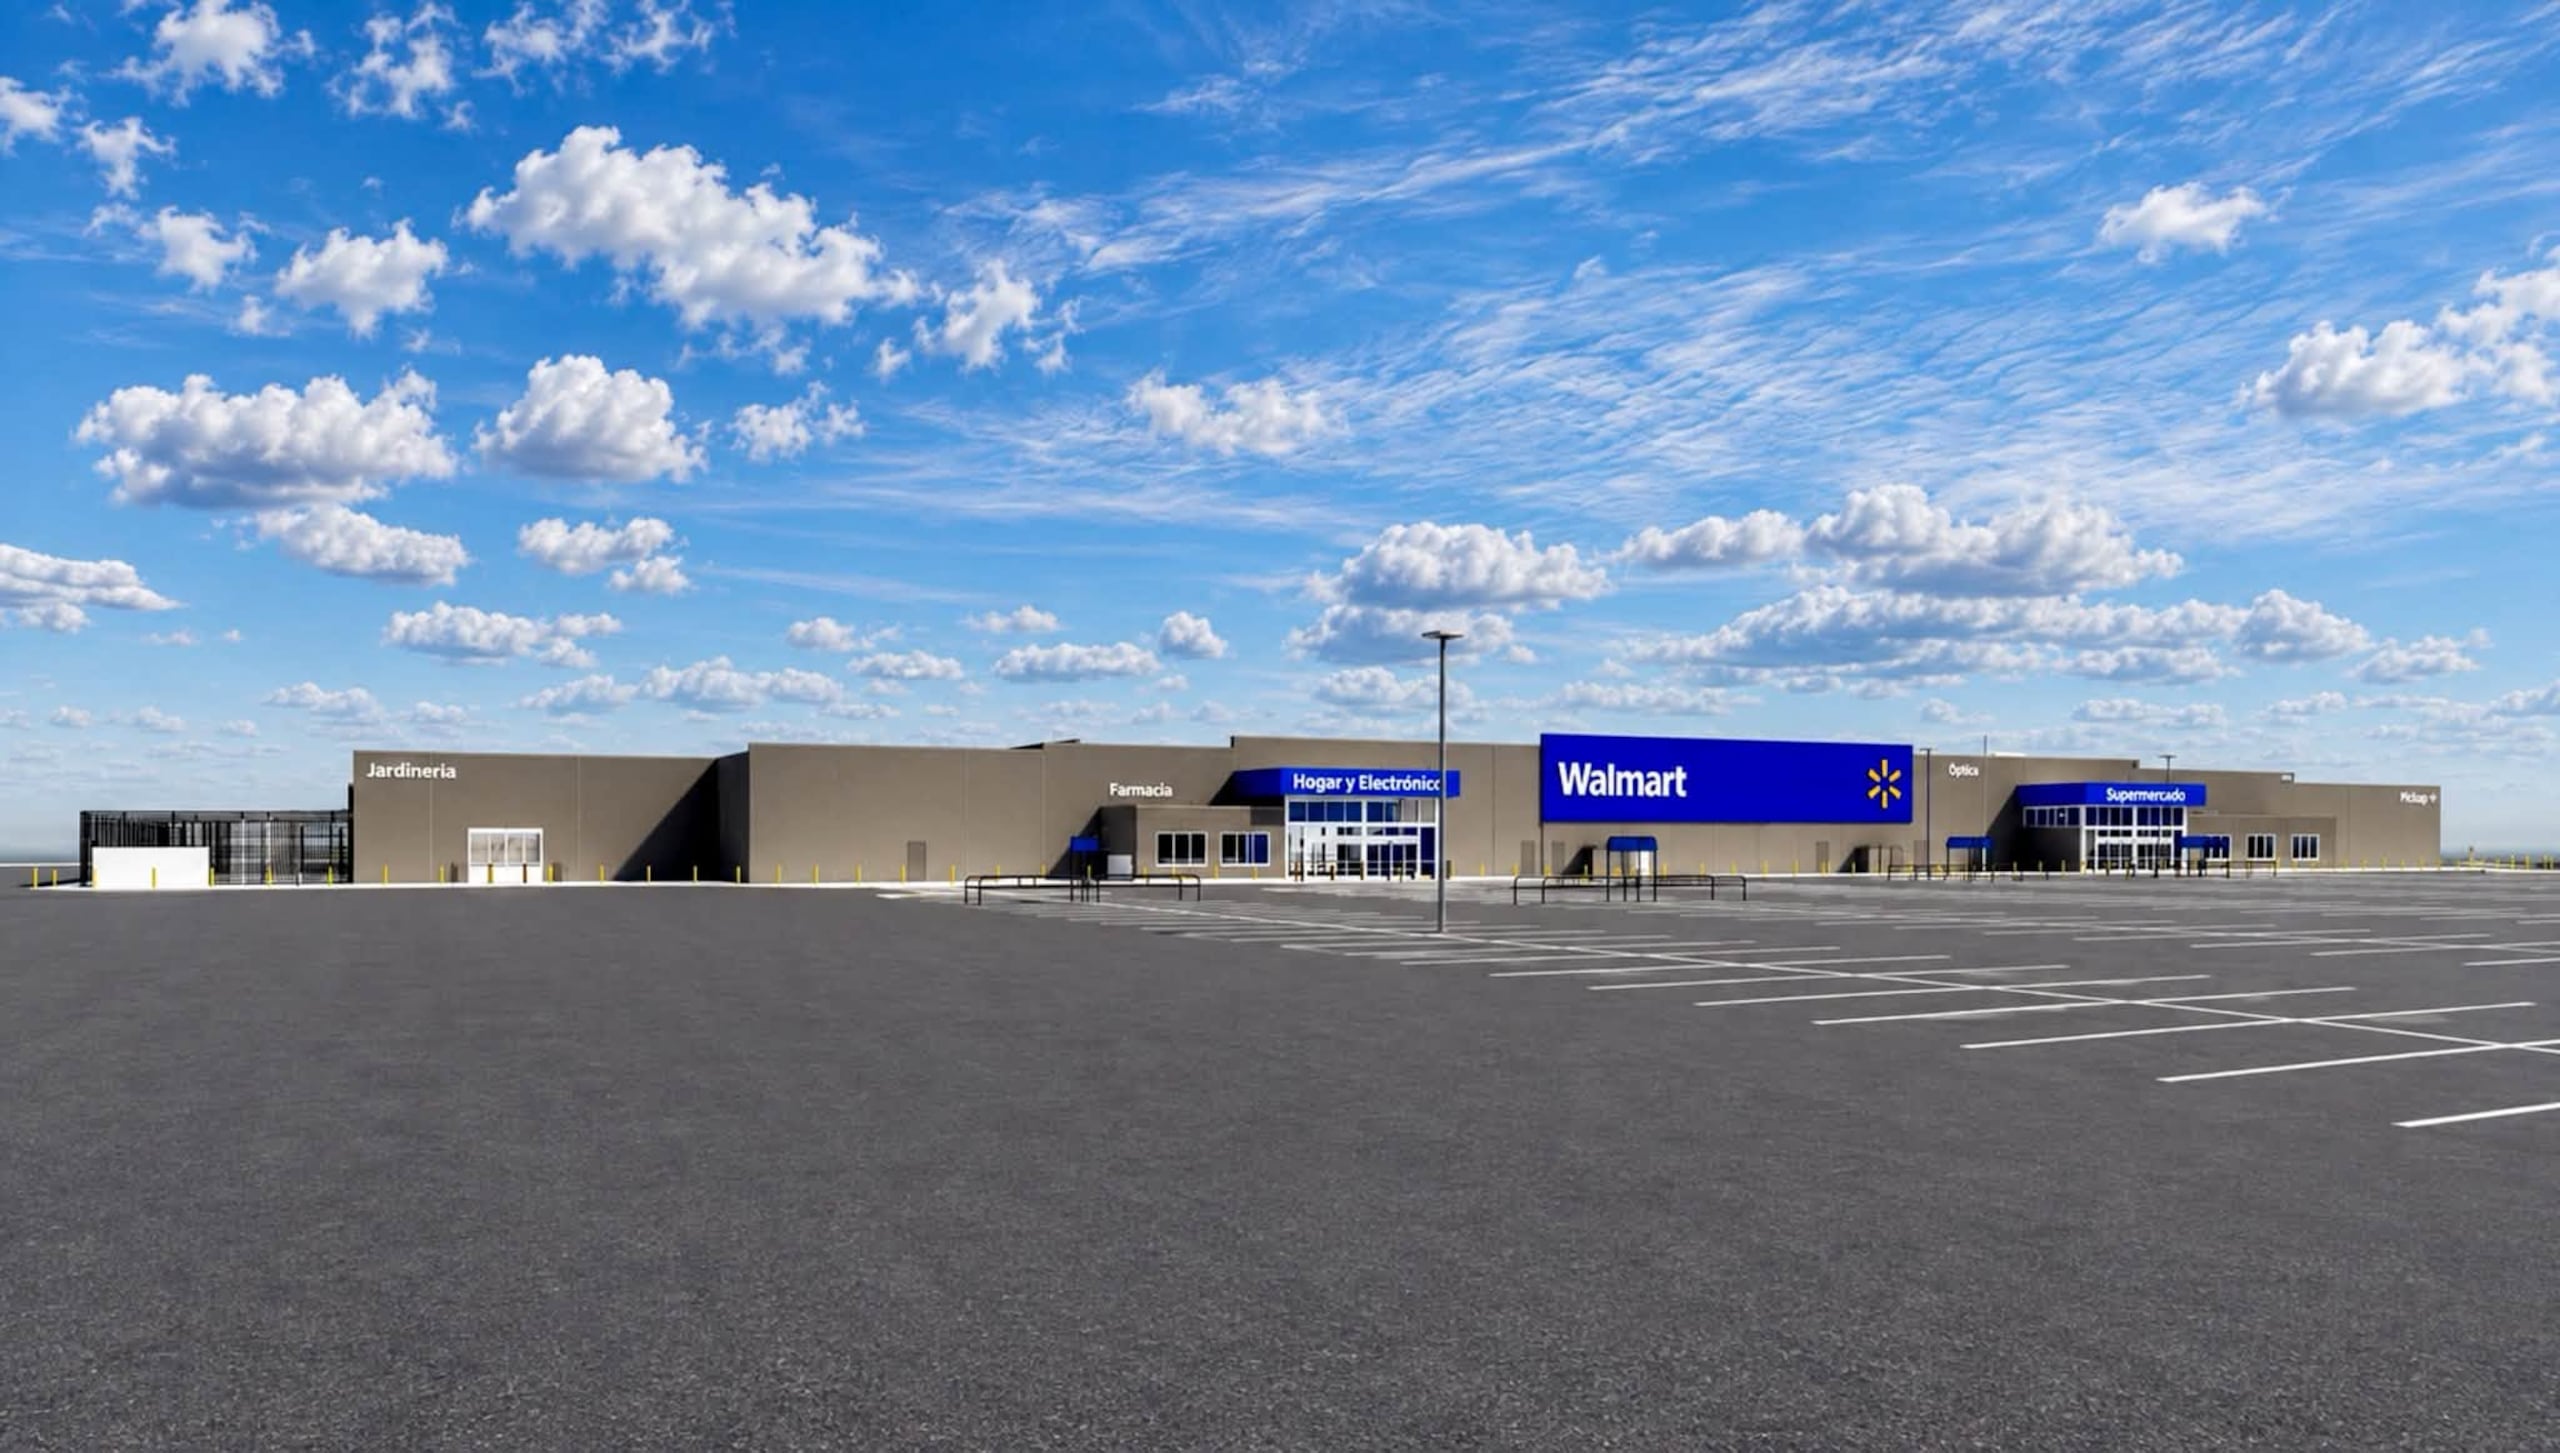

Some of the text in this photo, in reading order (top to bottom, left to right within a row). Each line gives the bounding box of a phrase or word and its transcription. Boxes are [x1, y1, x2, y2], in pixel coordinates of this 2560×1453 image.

[1293, 773, 1342, 793] Hogar
[1346, 777, 1355, 793] y
[1558, 761, 1687, 798] Walmart
[1109, 781, 1174, 797] Farmacia
[2106, 787, 2186, 804] Supermercado
